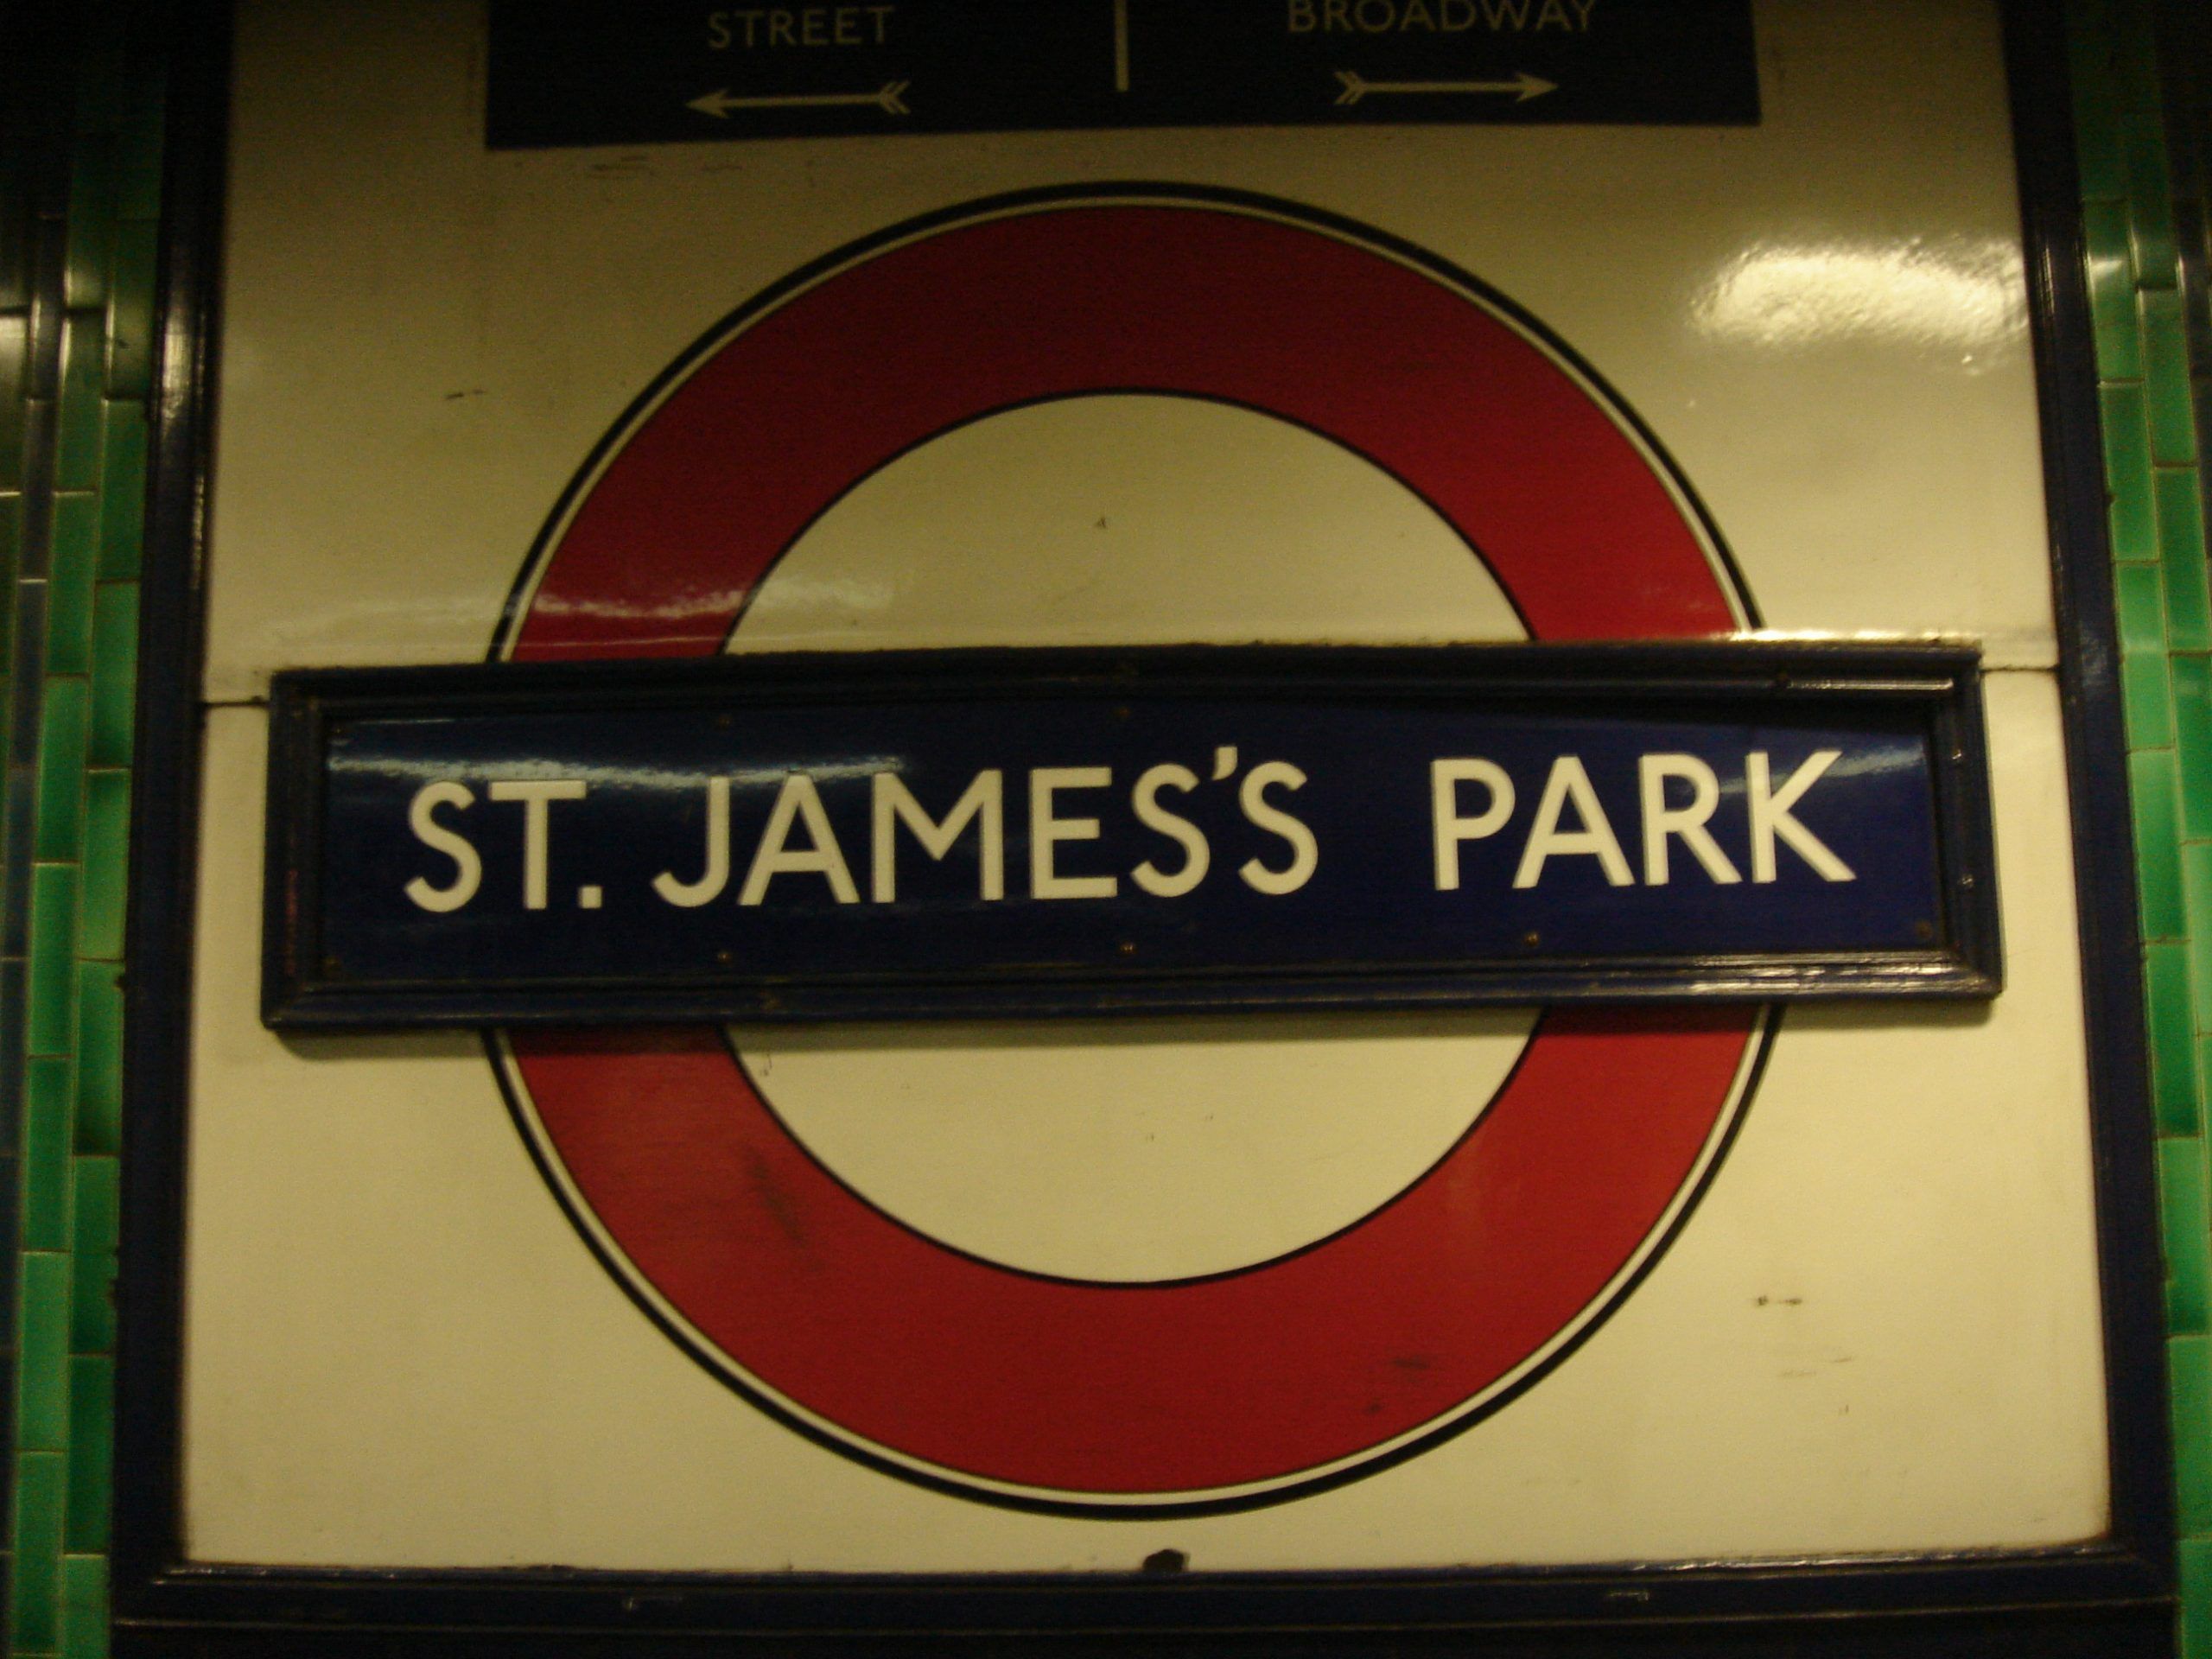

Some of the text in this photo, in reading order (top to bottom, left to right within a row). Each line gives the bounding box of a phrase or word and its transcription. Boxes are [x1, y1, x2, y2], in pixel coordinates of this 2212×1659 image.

[707, 6, 895, 50] STREET
[1287, 0, 1595, 33] BROADWAY
[405, 746, 1857, 913] ST. JAMES'S PARK
